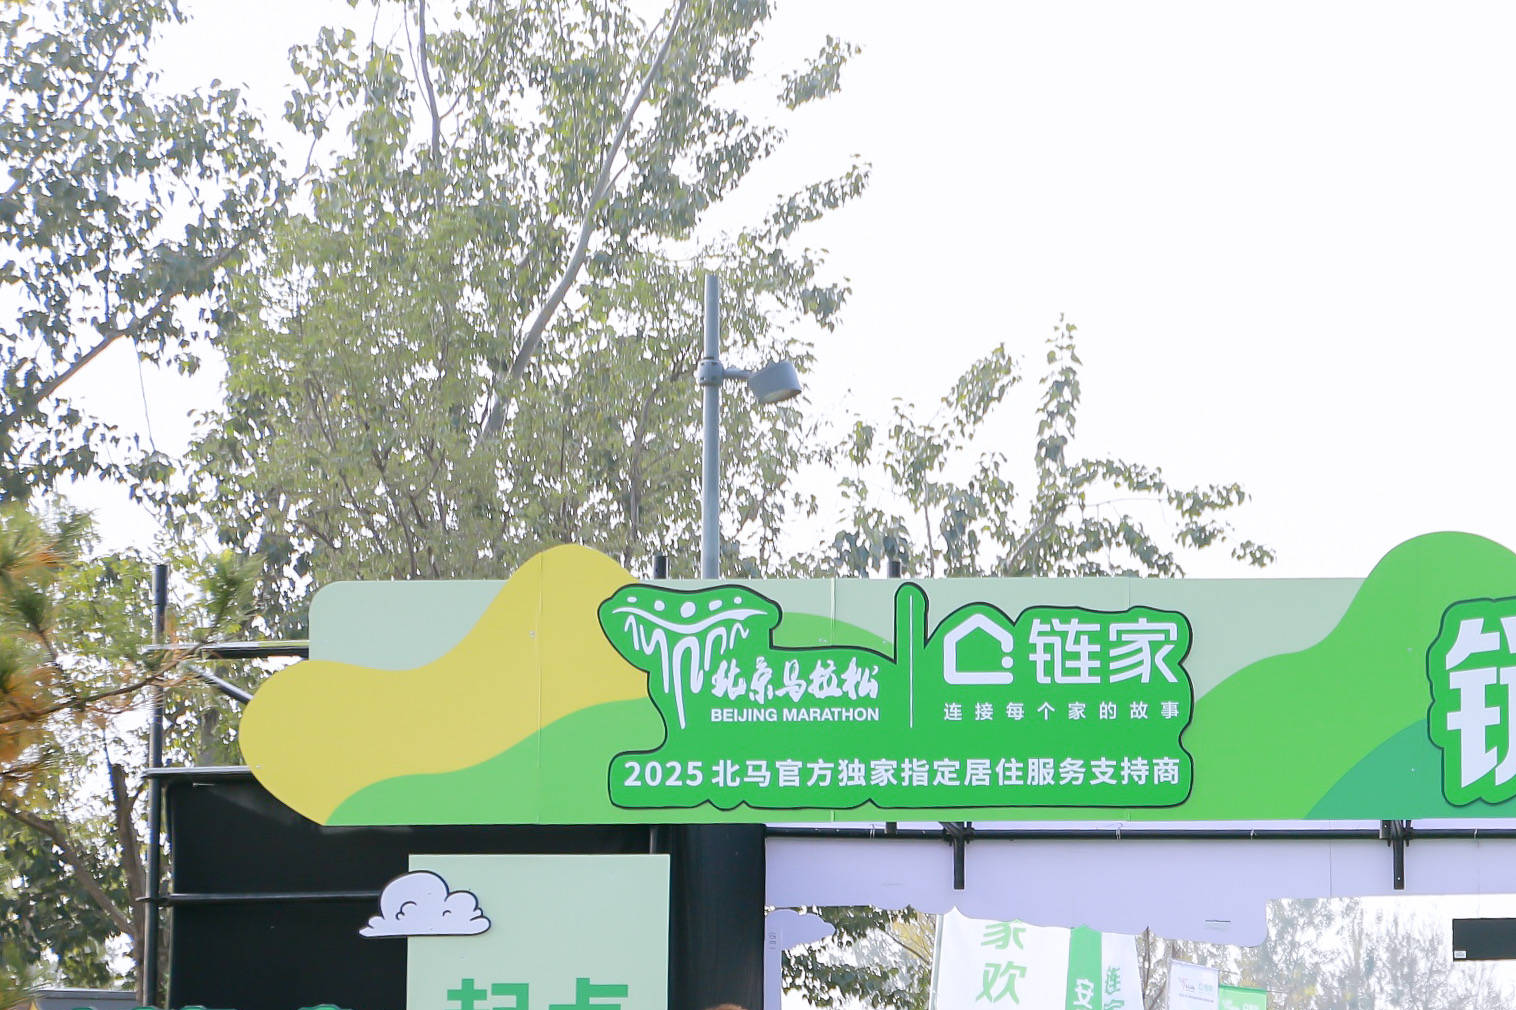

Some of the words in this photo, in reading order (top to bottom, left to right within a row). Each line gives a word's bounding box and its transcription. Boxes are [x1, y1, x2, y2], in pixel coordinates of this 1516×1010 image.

[1029, 618, 1178, 683] 链家
[711, 656, 879, 704] 北京马拉松
[711, 708, 777, 722] BEIJING
[783, 708, 880, 721] MARATHON
[944, 702, 1179, 720] 连接每个家的故事
[624, 761, 703, 787] 2025
[711, 758, 1180, 787] 北马官方独家指定居住服务支持商
